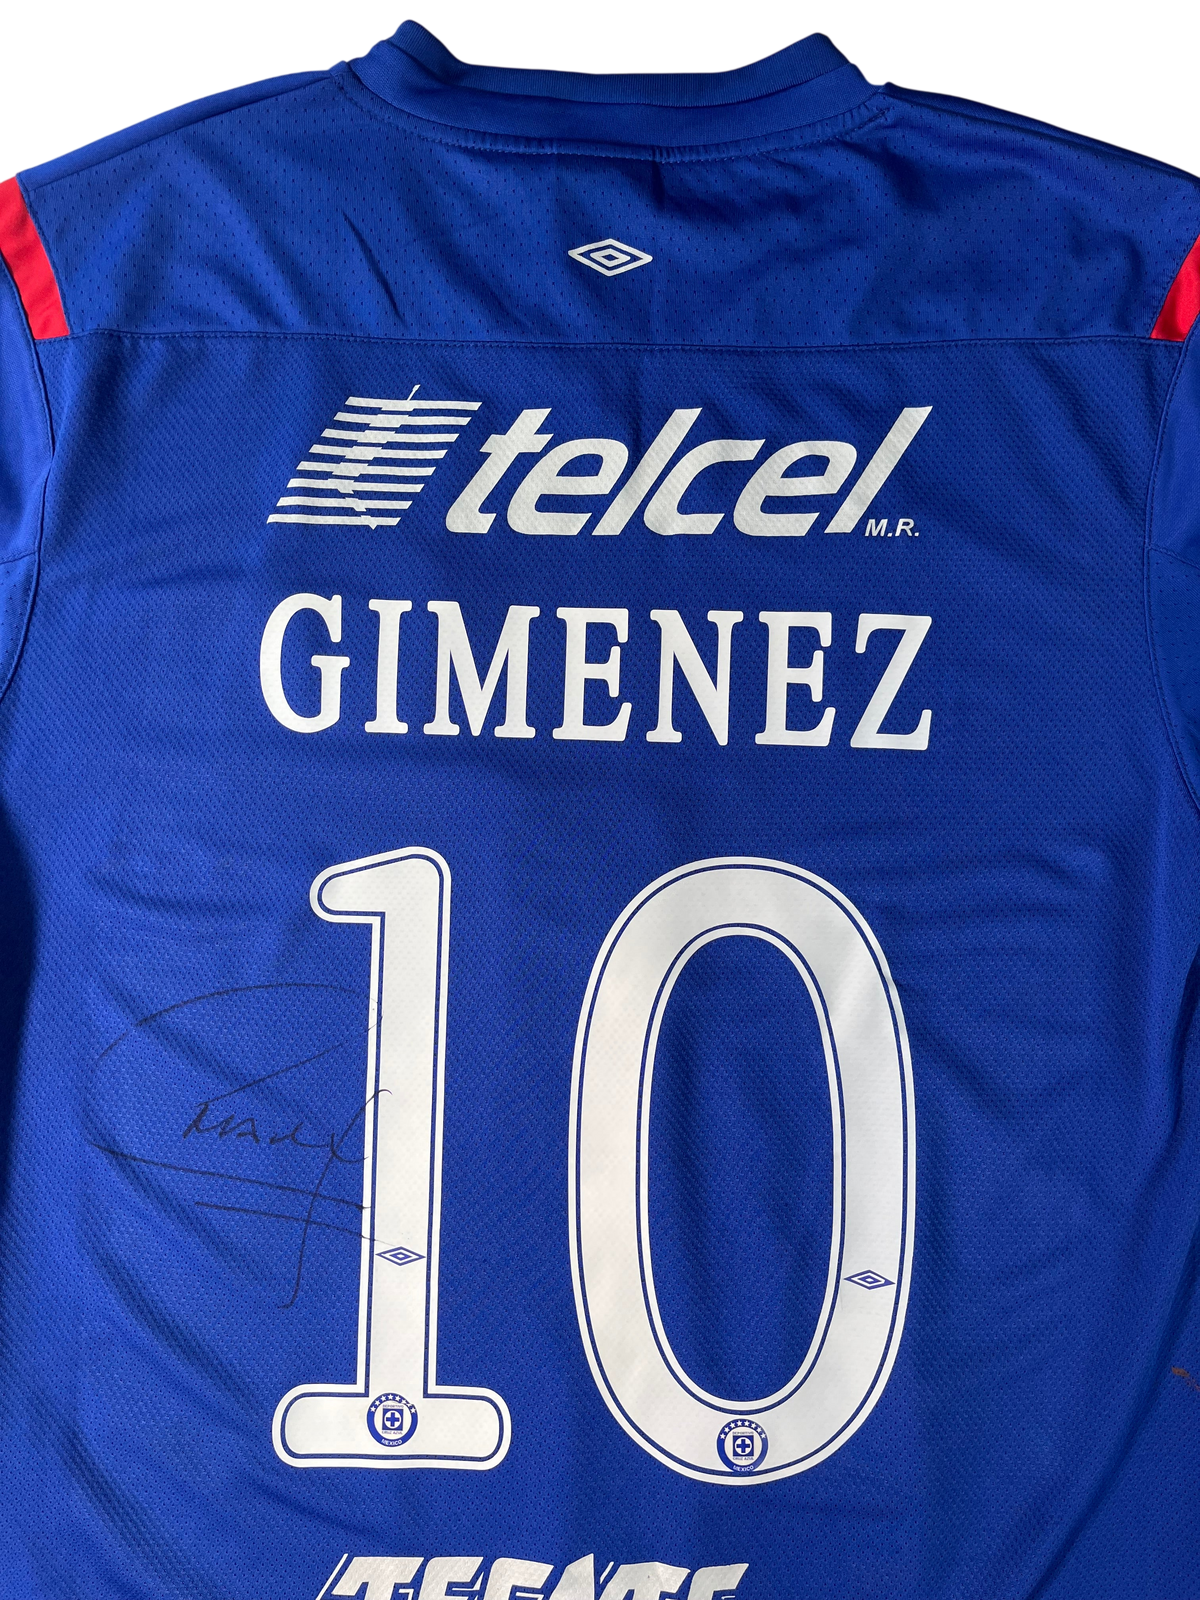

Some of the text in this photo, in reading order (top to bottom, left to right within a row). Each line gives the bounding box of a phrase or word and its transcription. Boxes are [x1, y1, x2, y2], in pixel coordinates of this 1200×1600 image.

[446, 406, 933, 536] telcel
[865, 518, 921, 537] M.R.
[260, 593, 932, 750] GIMENEZ
[272, 846, 916, 1485] 10
